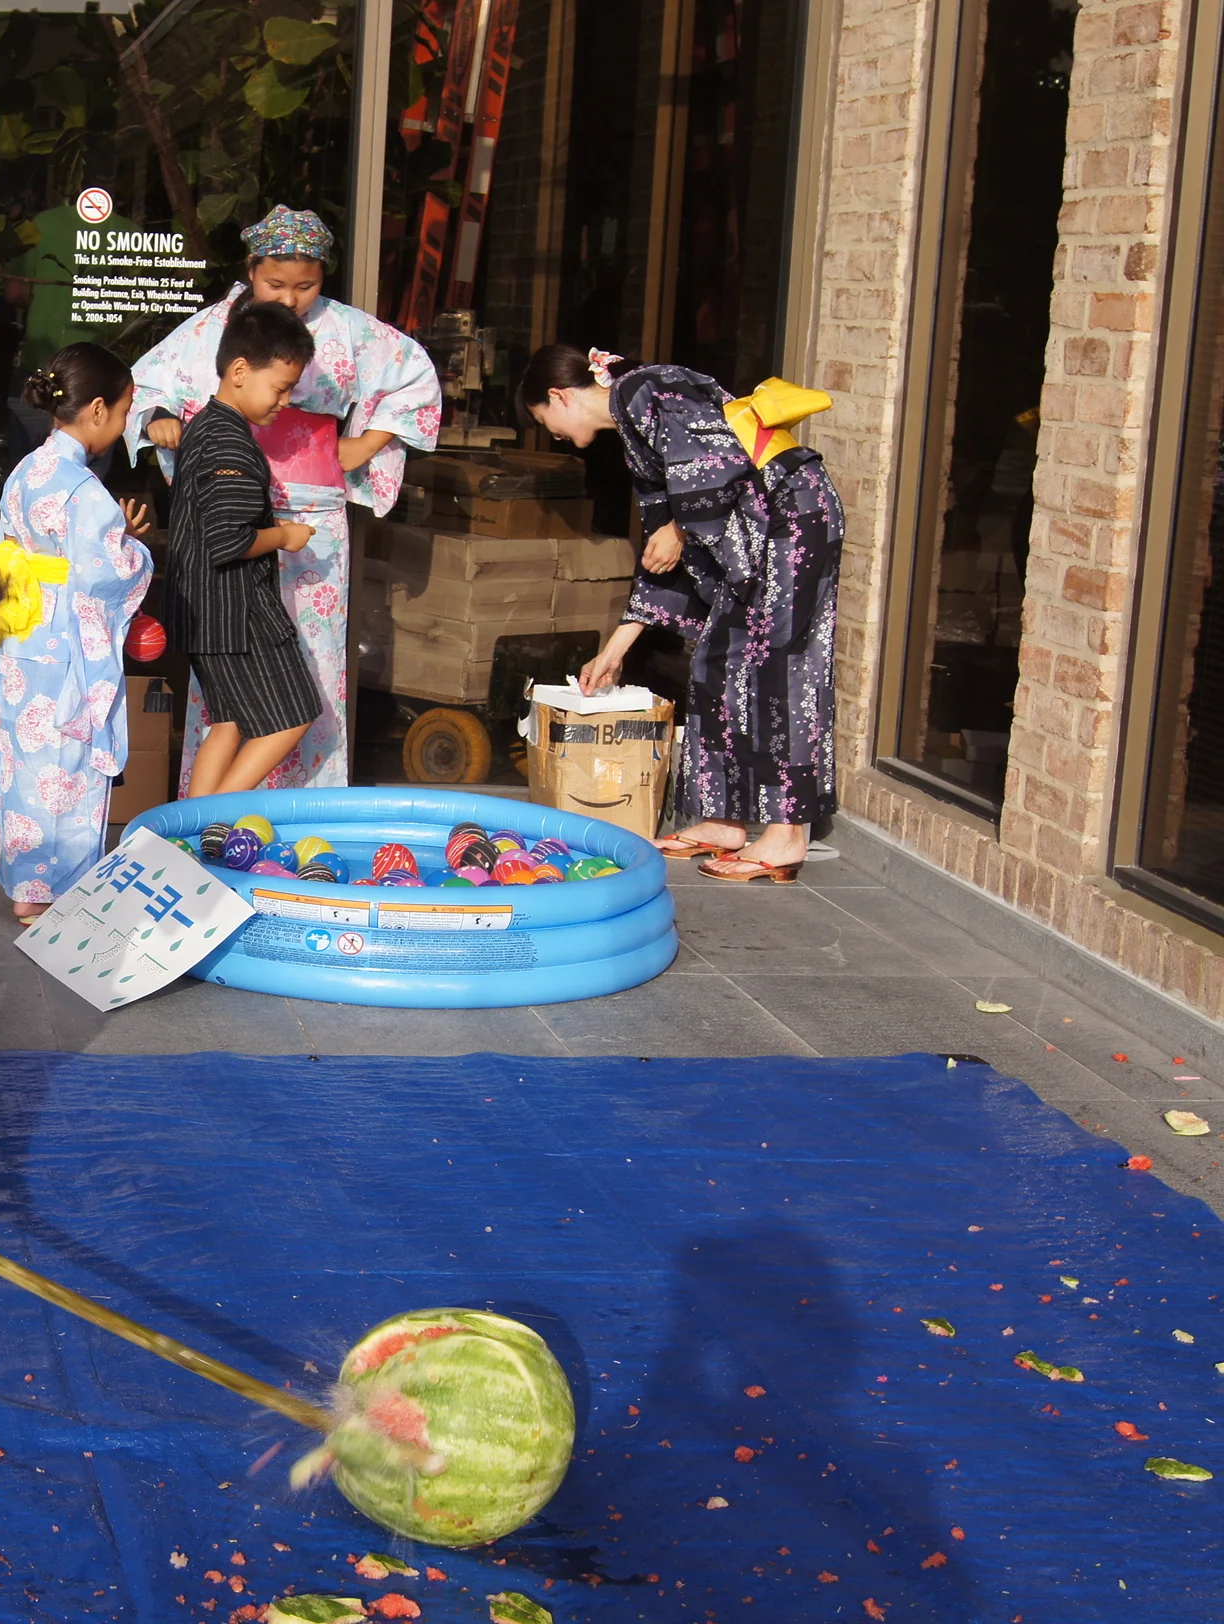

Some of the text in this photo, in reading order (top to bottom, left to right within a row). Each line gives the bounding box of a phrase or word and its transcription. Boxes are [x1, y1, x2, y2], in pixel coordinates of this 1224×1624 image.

[76, 230, 184, 253] NO SMOKING
[74, 254, 206, 269] This Is A Smoke-Free Establishment
[73, 275, 193, 288] Smoking Prohibited Within 25 Feet of
[72, 288, 99, 299] Building
[100, 289, 130, 299] Entrance,
[131, 290, 145, 300] Exit,
[147, 291, 182, 300] Wheelchair
[81, 300, 112, 311] Openable
[114, 303, 139, 311] Window
[141, 303, 150, 313] By
[150, 303, 163, 313] City
[165, 303, 197, 313] Ordinance
[71, 312, 122, 323] No. 2006-1054
[97, 853, 195, 929] 水ヨーヨー
